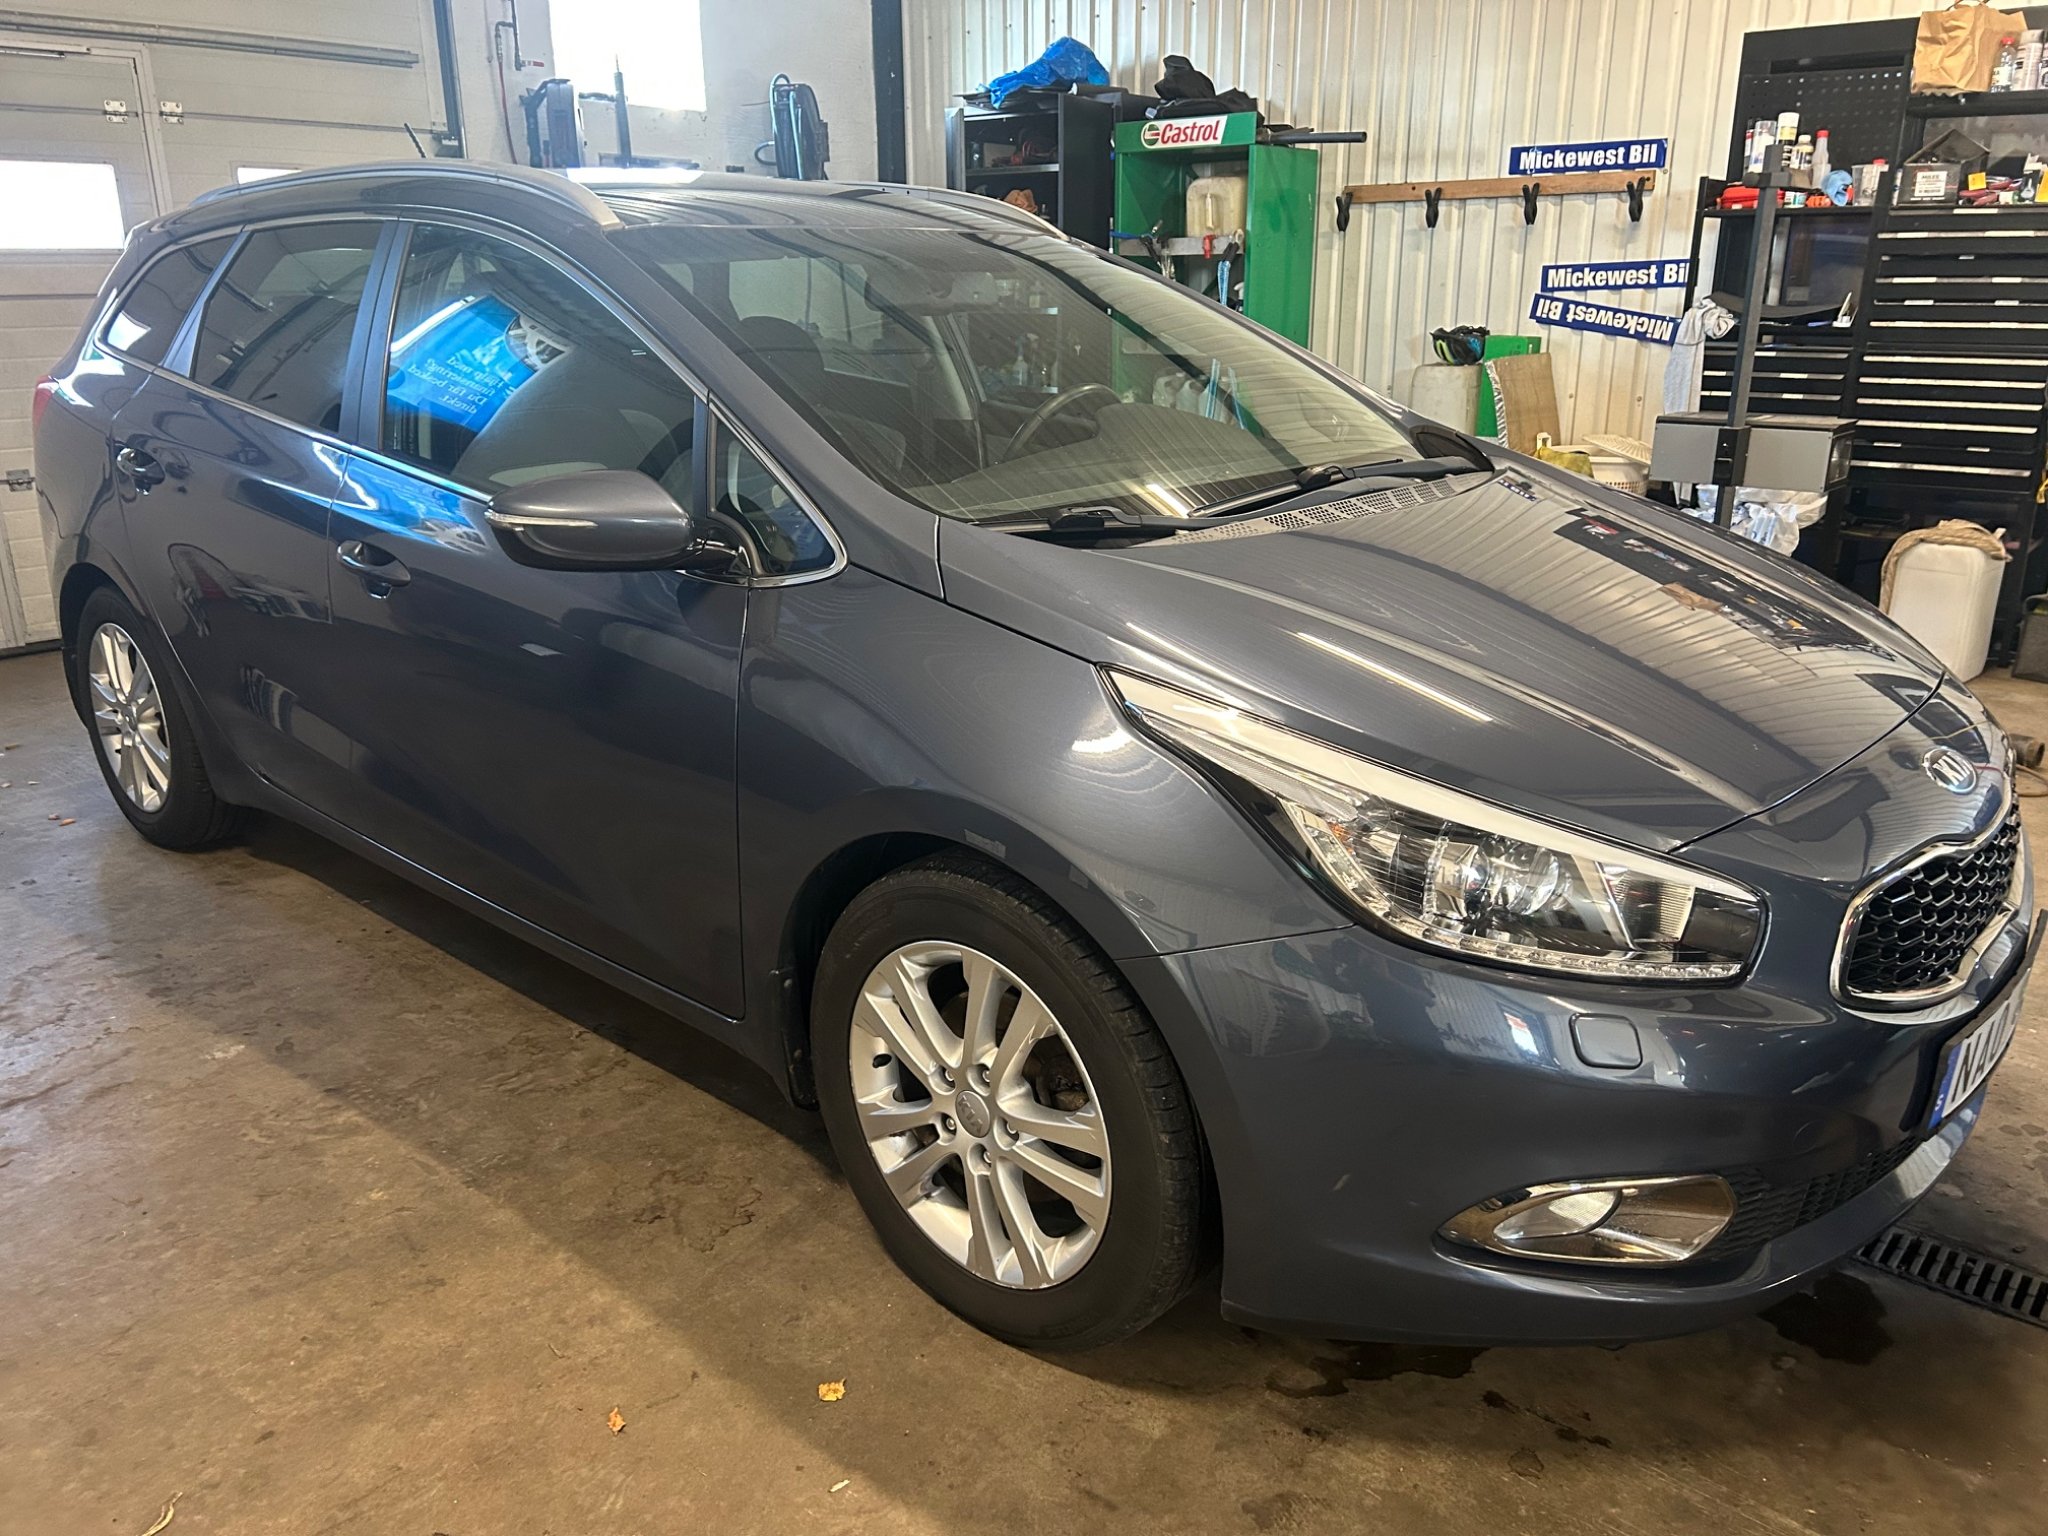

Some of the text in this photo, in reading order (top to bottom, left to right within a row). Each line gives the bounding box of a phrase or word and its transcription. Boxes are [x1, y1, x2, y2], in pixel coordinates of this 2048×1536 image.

[1161, 120, 1221, 144] Castrol
[1519, 144, 1658, 171] Mickewest Bil
[1547, 264, 1658, 288] Mickewest
[1536, 298, 1674, 341] Mickewest Bil
